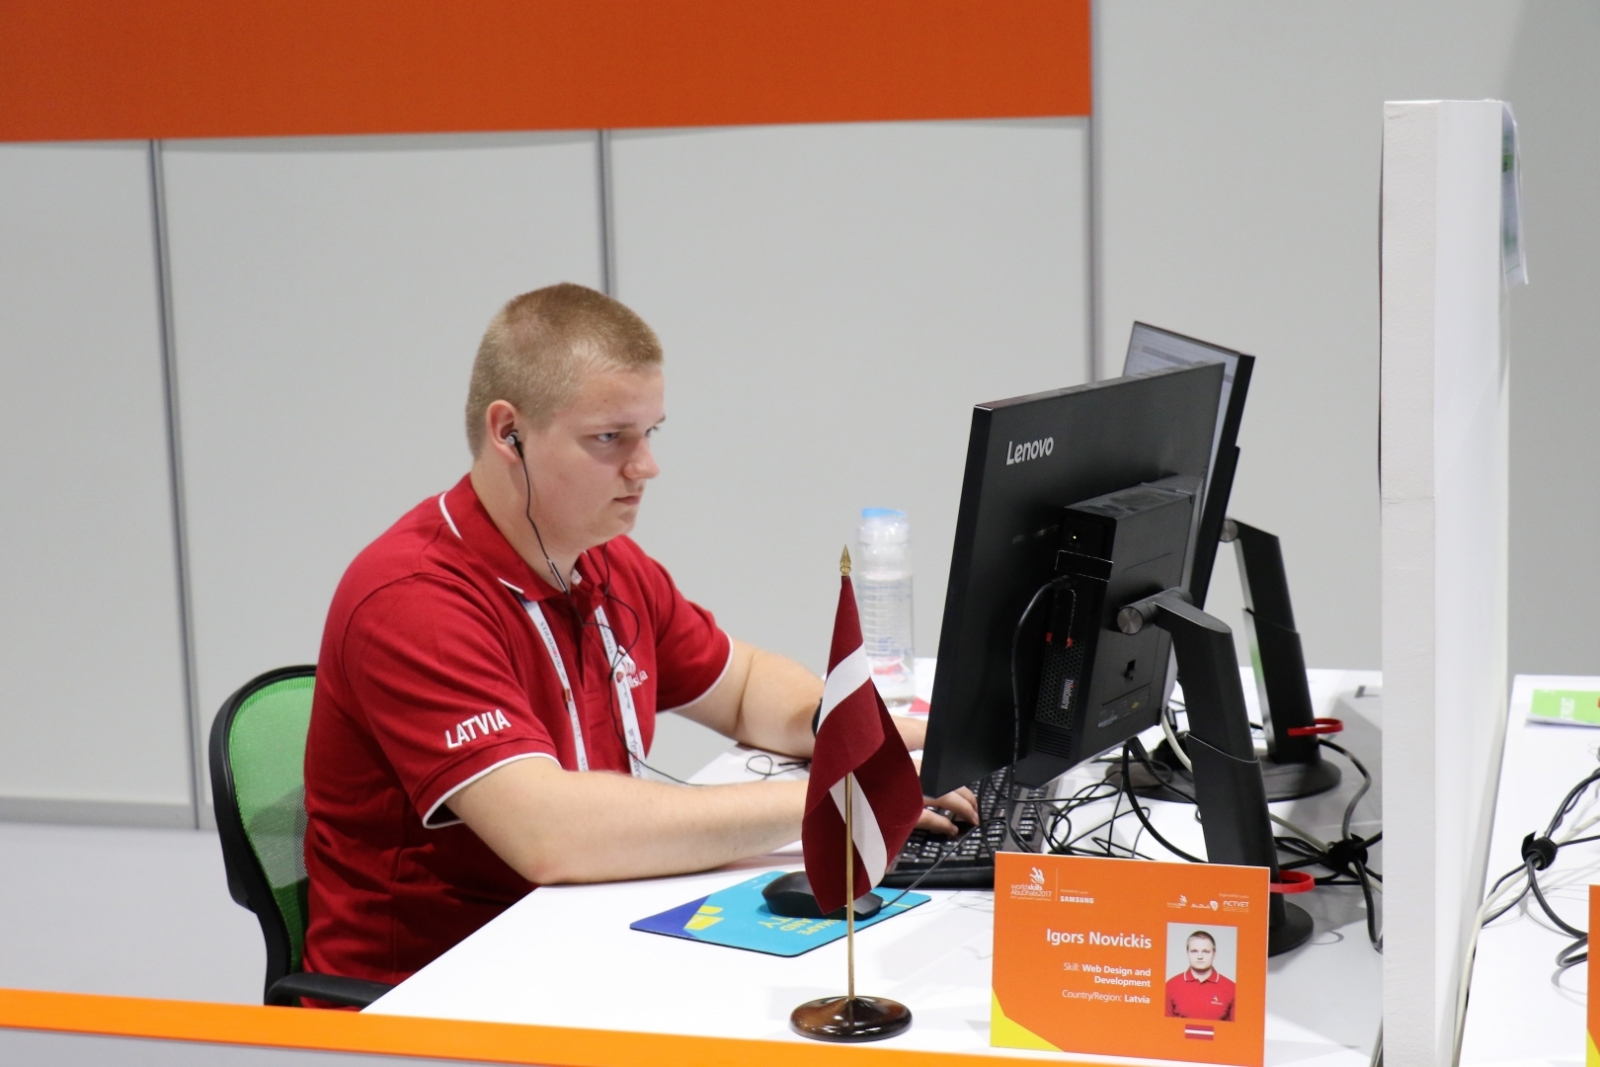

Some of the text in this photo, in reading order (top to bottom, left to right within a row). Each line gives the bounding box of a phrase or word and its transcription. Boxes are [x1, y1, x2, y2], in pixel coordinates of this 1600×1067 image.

[1006, 437, 1054, 465] Lenovo
[445, 709, 512, 749] LATVIA
[1060, 895, 1094, 904] SAMSUNG
[1046, 928, 1152, 949] Igors Novickis
[1082, 964, 1101, 973] Web
[1104, 965, 1132, 976] Design
[1134, 968, 1151, 976] and
[1094, 975, 1151, 987] Development
[1062, 989, 1151, 1004] Country/Region: Latvia
